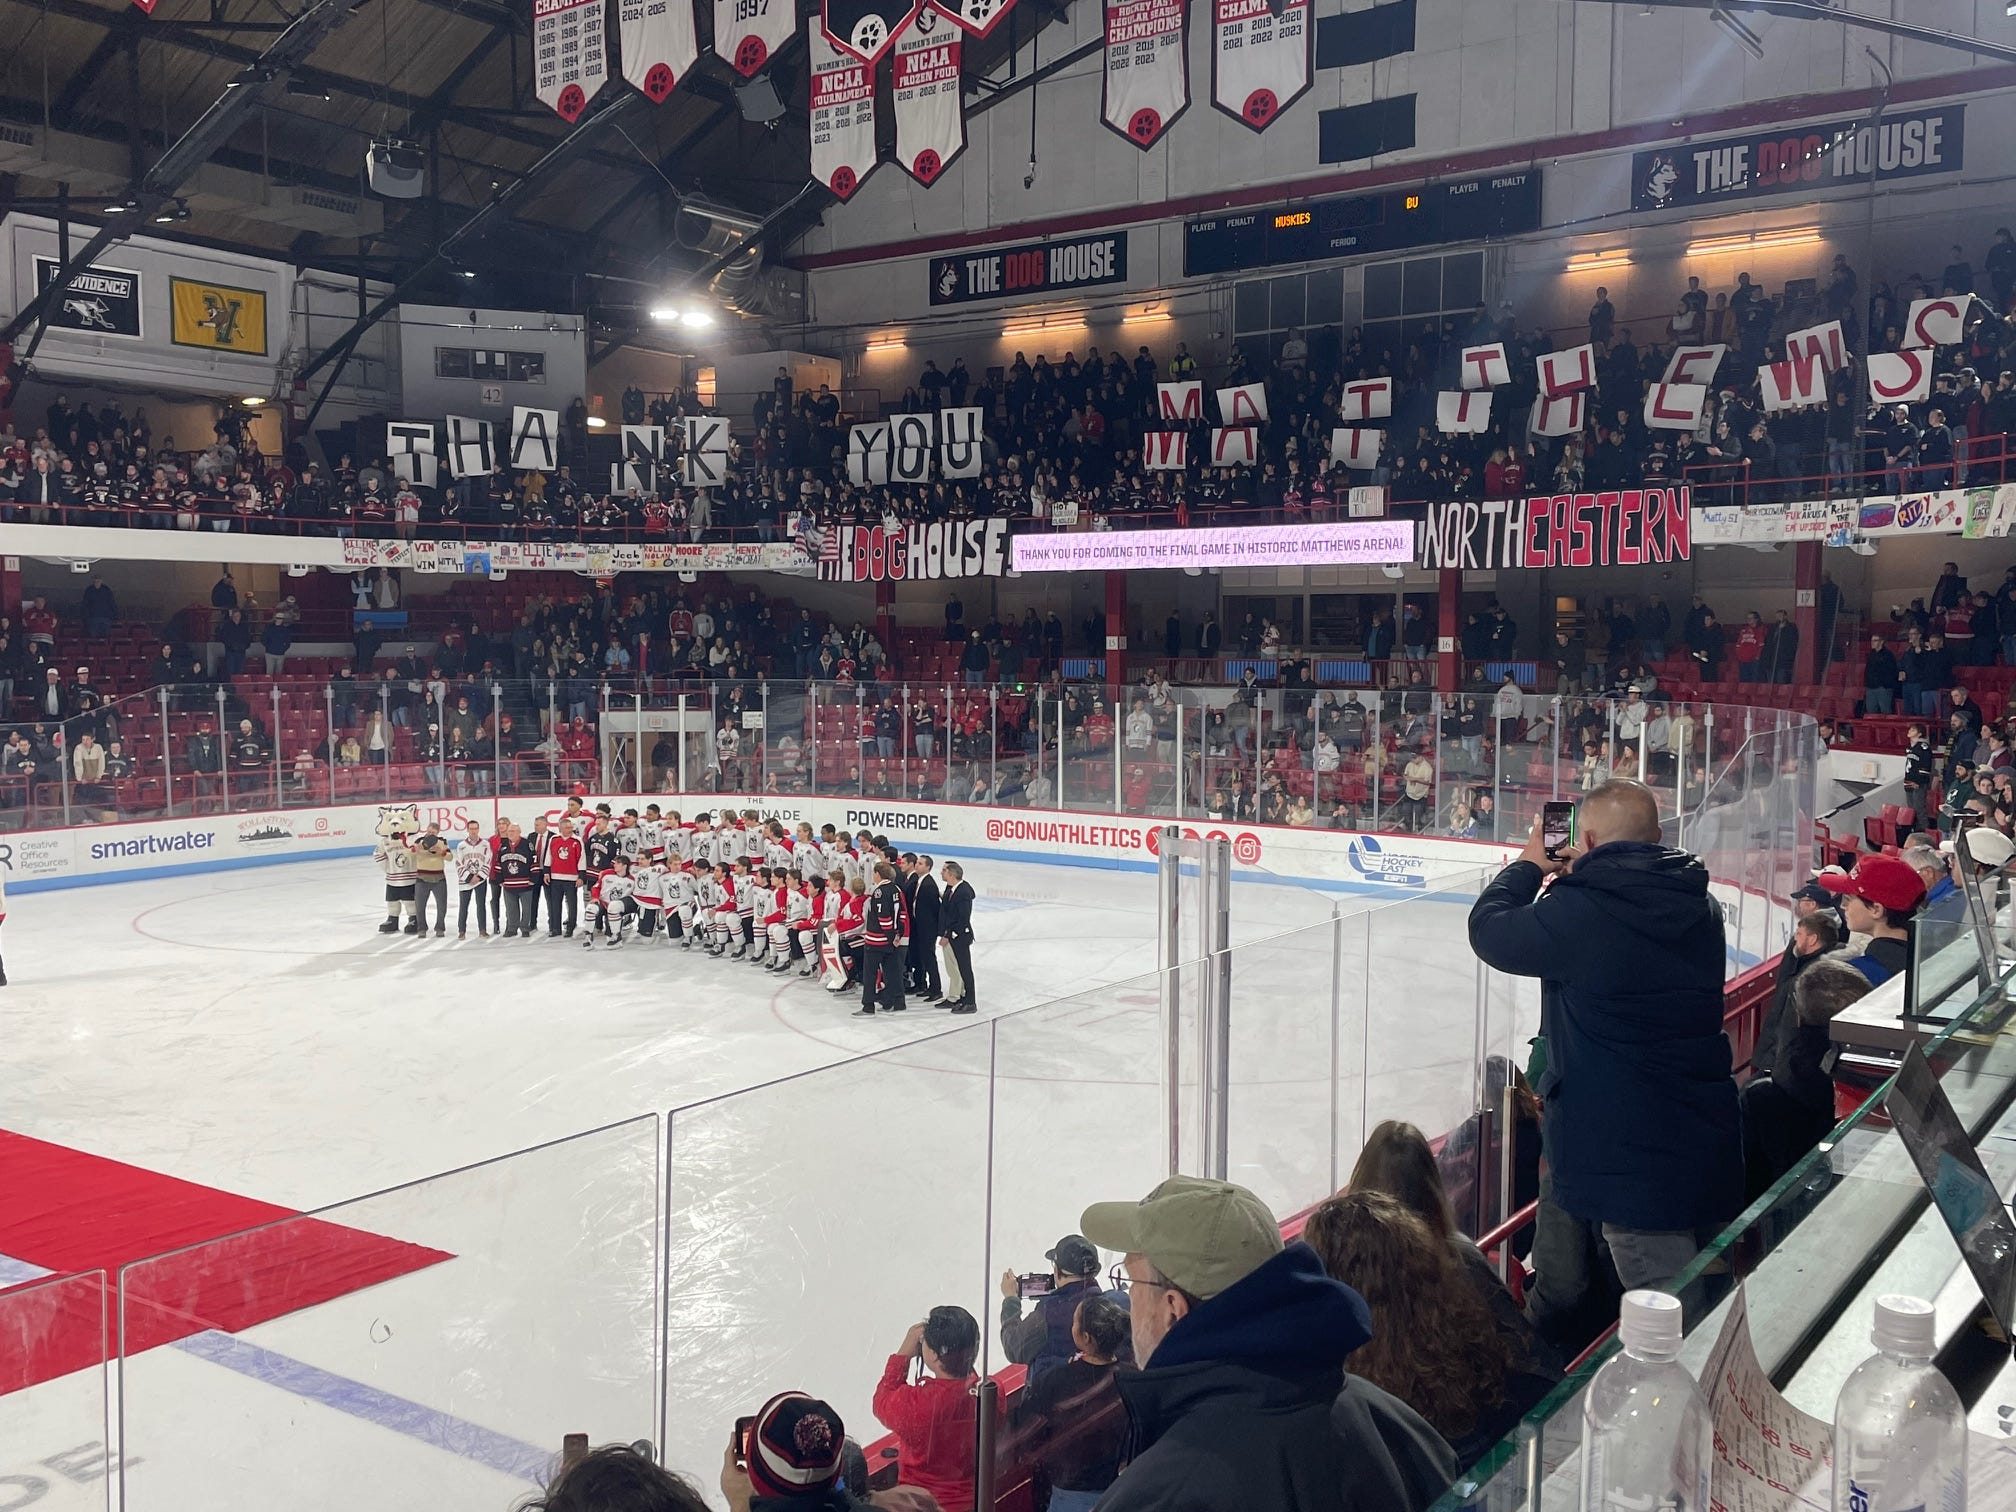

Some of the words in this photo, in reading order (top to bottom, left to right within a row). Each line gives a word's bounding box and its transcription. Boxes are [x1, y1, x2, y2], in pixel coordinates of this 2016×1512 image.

[561, 11, 578, 25] 1980
[584, 4, 601, 19] 1984
[622, 7, 644, 22] 2024
[647, 2, 666, 16] 2025
[1110, 12, 1149, 28] REGULAR
[1151, 4, 1180, 19] SEASON
[1119, 1, 1152, 17] HOCKEY
[584, 19, 602, 33] 1987
[1109, 13, 1182, 43] CHAMPIONS
[1223, 23, 1243, 36] 2018
[1252, 16, 1272, 30] 2019
[1279, 10, 1302, 24] 2020
[584, 34, 602, 48] 1990
[931, 32, 955, 47] HOCKEY
[1111, 44, 1129, 58] 2012
[1160, 32, 1179, 47] 2020
[1223, 37, 1243, 51] 2021
[1250, 31, 1273, 45] 2022
[1279, 25, 1302, 39] 2023
[540, 61, 555, 74] 1991
[562, 55, 579, 69] 1994
[906, 47, 949, 74] NCAA
[1110, 57, 1129, 71] 2022
[1135, 52, 1155, 66] 2023
[562, 70, 579, 84] 1998
[585, 63, 602, 77] 2012
[821, 69, 863, 93] NCAA
[899, 70, 933, 87] FROZEN
[934, 65, 957, 79] FOUR
[813, 85, 872, 107] TOURNAMENT
[814, 133, 831, 144] 2023
[1693, 145, 1749, 194] THE
[1757, 133, 1823, 188] DOG
[1832, 117, 1943, 177] HOUSE
[1450, 183, 1479, 195] PLAYER
[1492, 175, 1527, 189] PENALTY
[1406, 195, 1419, 210] BU
[1191, 222, 1216, 233] PLAYER
[1226, 216, 1256, 228] PENALTY
[1275, 212, 1311, 228] HUSKIES
[1330, 237, 1357, 248] PERIOD
[966, 257, 1000, 294] THE
[1005, 251, 1044, 289] DOG
[1050, 239, 1115, 284] HOUSE
[483, 388, 501, 403] 42
[855, 412, 975, 483] YOU
[441, 541, 457, 549] GET
[676, 546, 703, 555] MOORE
[735, 546, 762, 555] HENRY
[854, 525, 906, 582] DOG
[907, 518, 1007, 580] HOUSE
[1020, 549, 1050, 561] THANK
[1052, 548, 1071, 559] YOU
[1073, 547, 1091, 559] FOR
[1093, 546, 1133, 559] COMING
[1135, 546, 1147, 557] TO
[1150, 545, 1168, 557] THE
[1170, 544, 1199, 556] FINAL
[1201, 543, 1230, 555] GAME
[1233, 542, 1246, 554] IN
[1247, 541, 1299, 554] HISTORIC
[1301, 538, 1361, 553] MATTHEWS
[1363, 537, 1404, 550] ARENA!
[344, 555, 377, 565] MARC
[1441, 640, 1451, 650] 16
[846, 810, 939, 831] POWERADE
[986, 819, 1142, 849] @GONUATHLETICS
[20, 841, 59, 851] Creative
[91, 830, 215, 861] smartwater
[20, 851, 49, 860] Office
[20, 859, 69, 869] Resources
[1382, 858, 1424, 867] HOCKEY
[1381, 865, 1406, 874] EAST
[877, 904, 882, 912] 7
